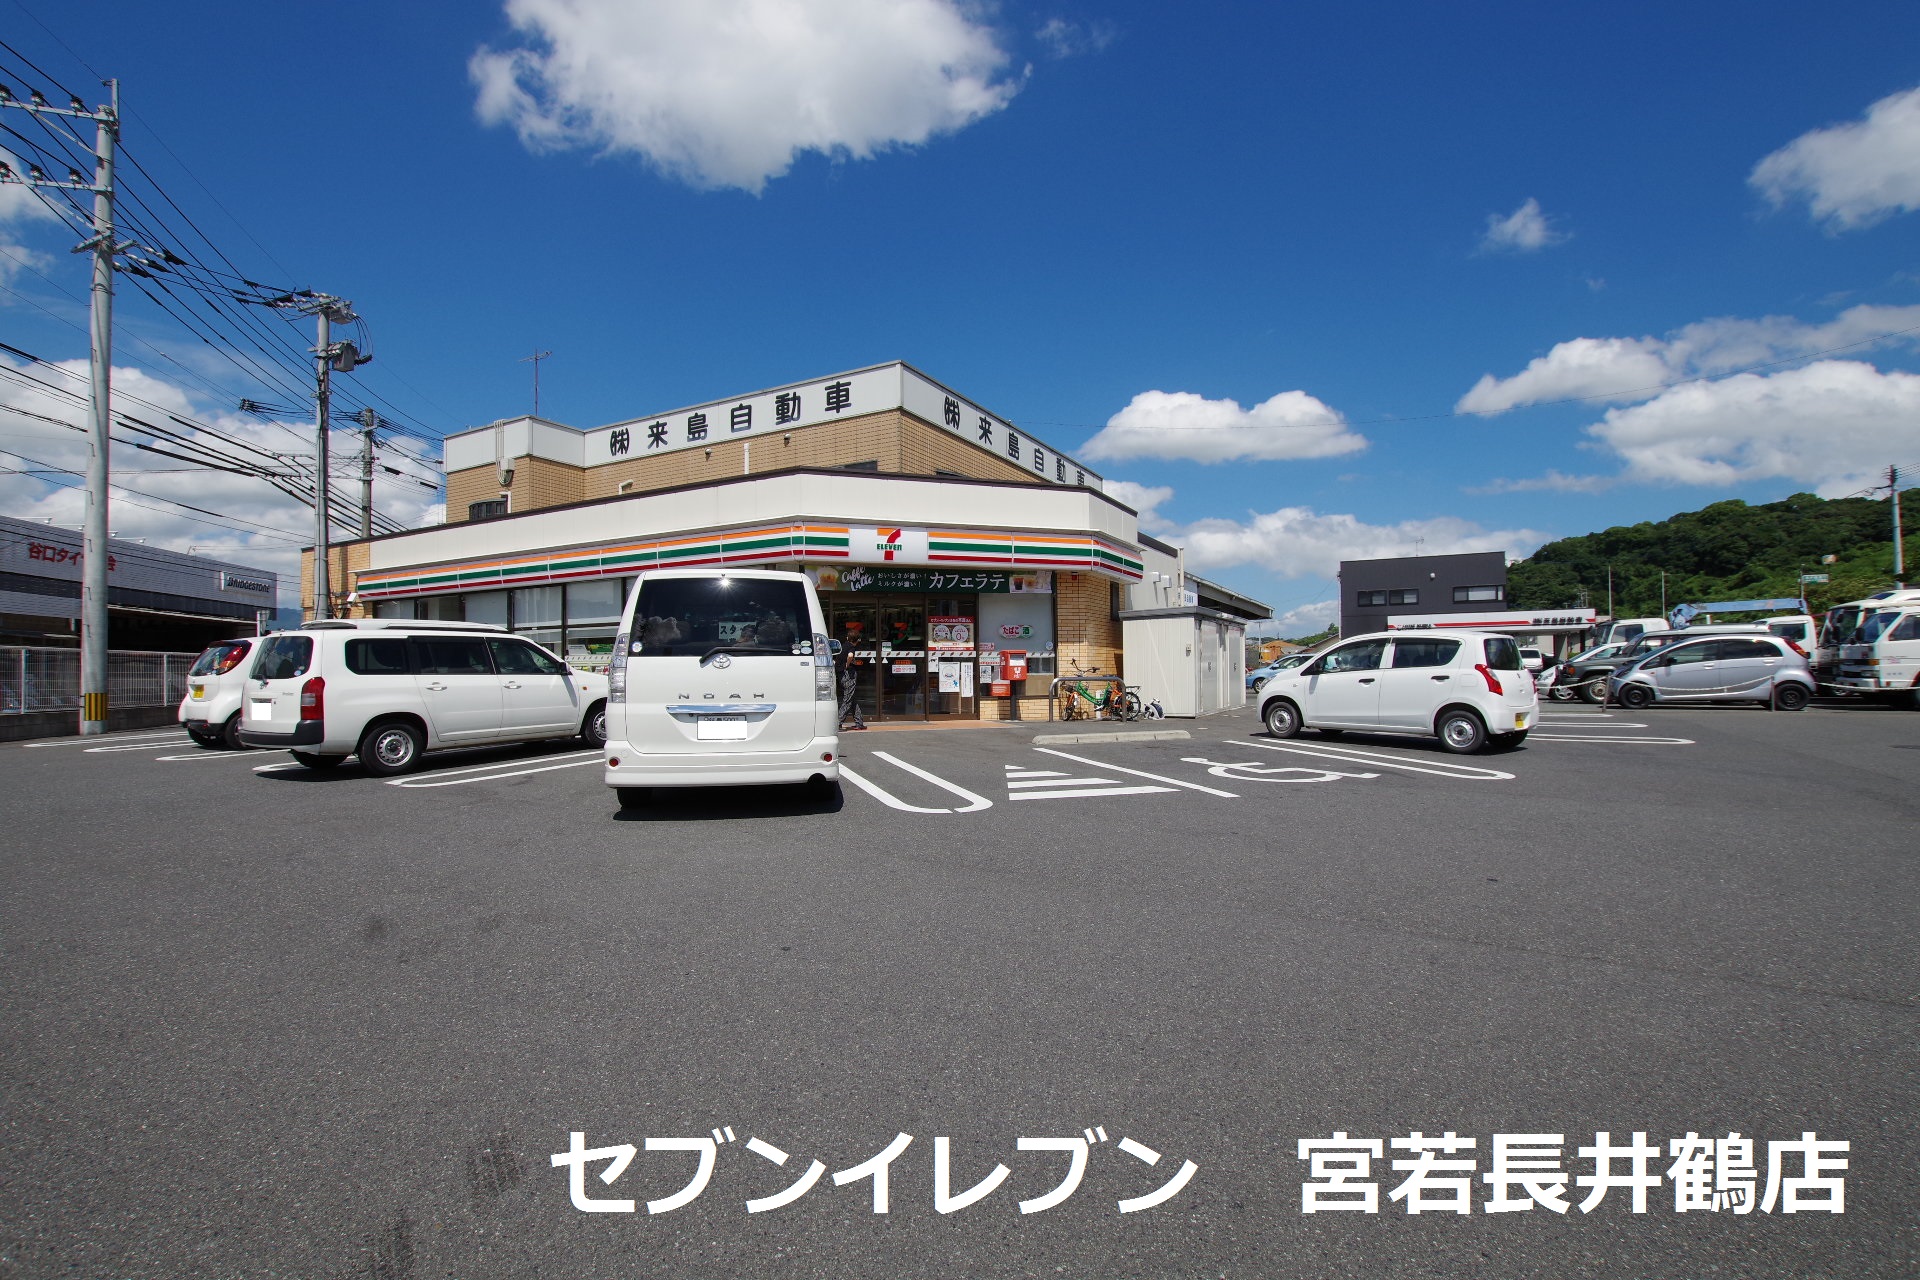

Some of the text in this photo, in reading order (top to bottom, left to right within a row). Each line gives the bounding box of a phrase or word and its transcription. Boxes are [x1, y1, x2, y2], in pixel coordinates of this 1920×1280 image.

[29, 541, 118, 572] 谷口タイ会
[226, 576, 271, 593] BRIDGESTONE
[929, 572, 1005, 590] カフェラテ
[1002, 626, 1020, 635] たばこ
